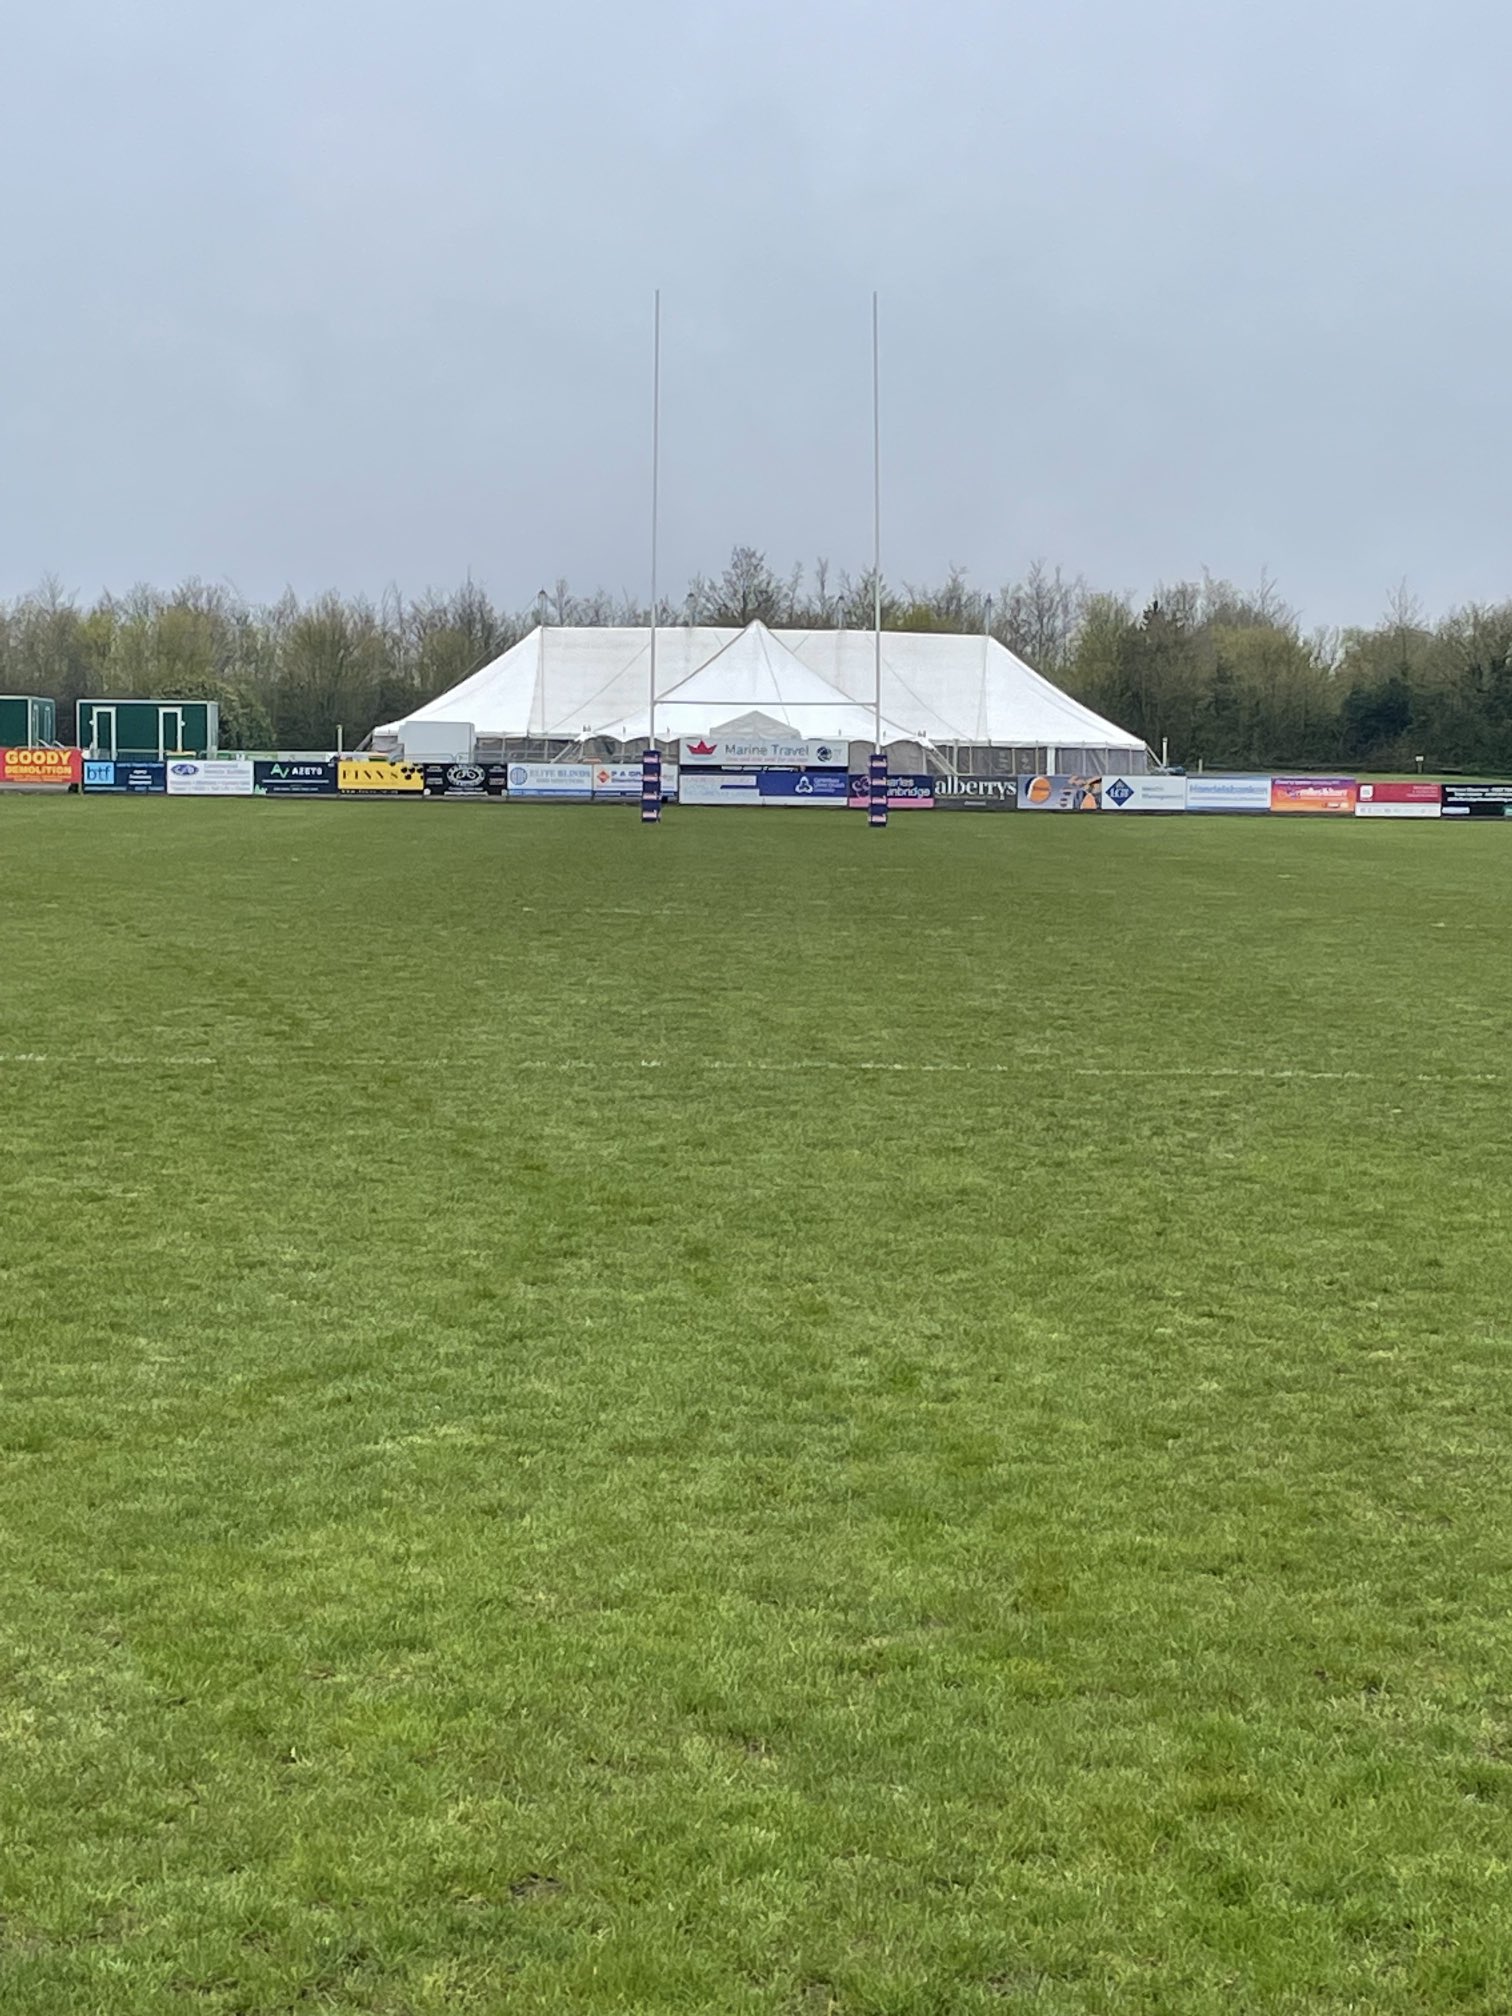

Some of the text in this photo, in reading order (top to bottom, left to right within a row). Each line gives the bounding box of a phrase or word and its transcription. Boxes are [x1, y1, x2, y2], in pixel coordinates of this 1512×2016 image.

[725, 743, 809, 756] Marine Travel
[5, 750, 71, 765] GOODY
[5, 765, 72, 774] DEMOLITION
[87, 765, 111, 780] btf
[935, 775, 1017, 800] alberrys
